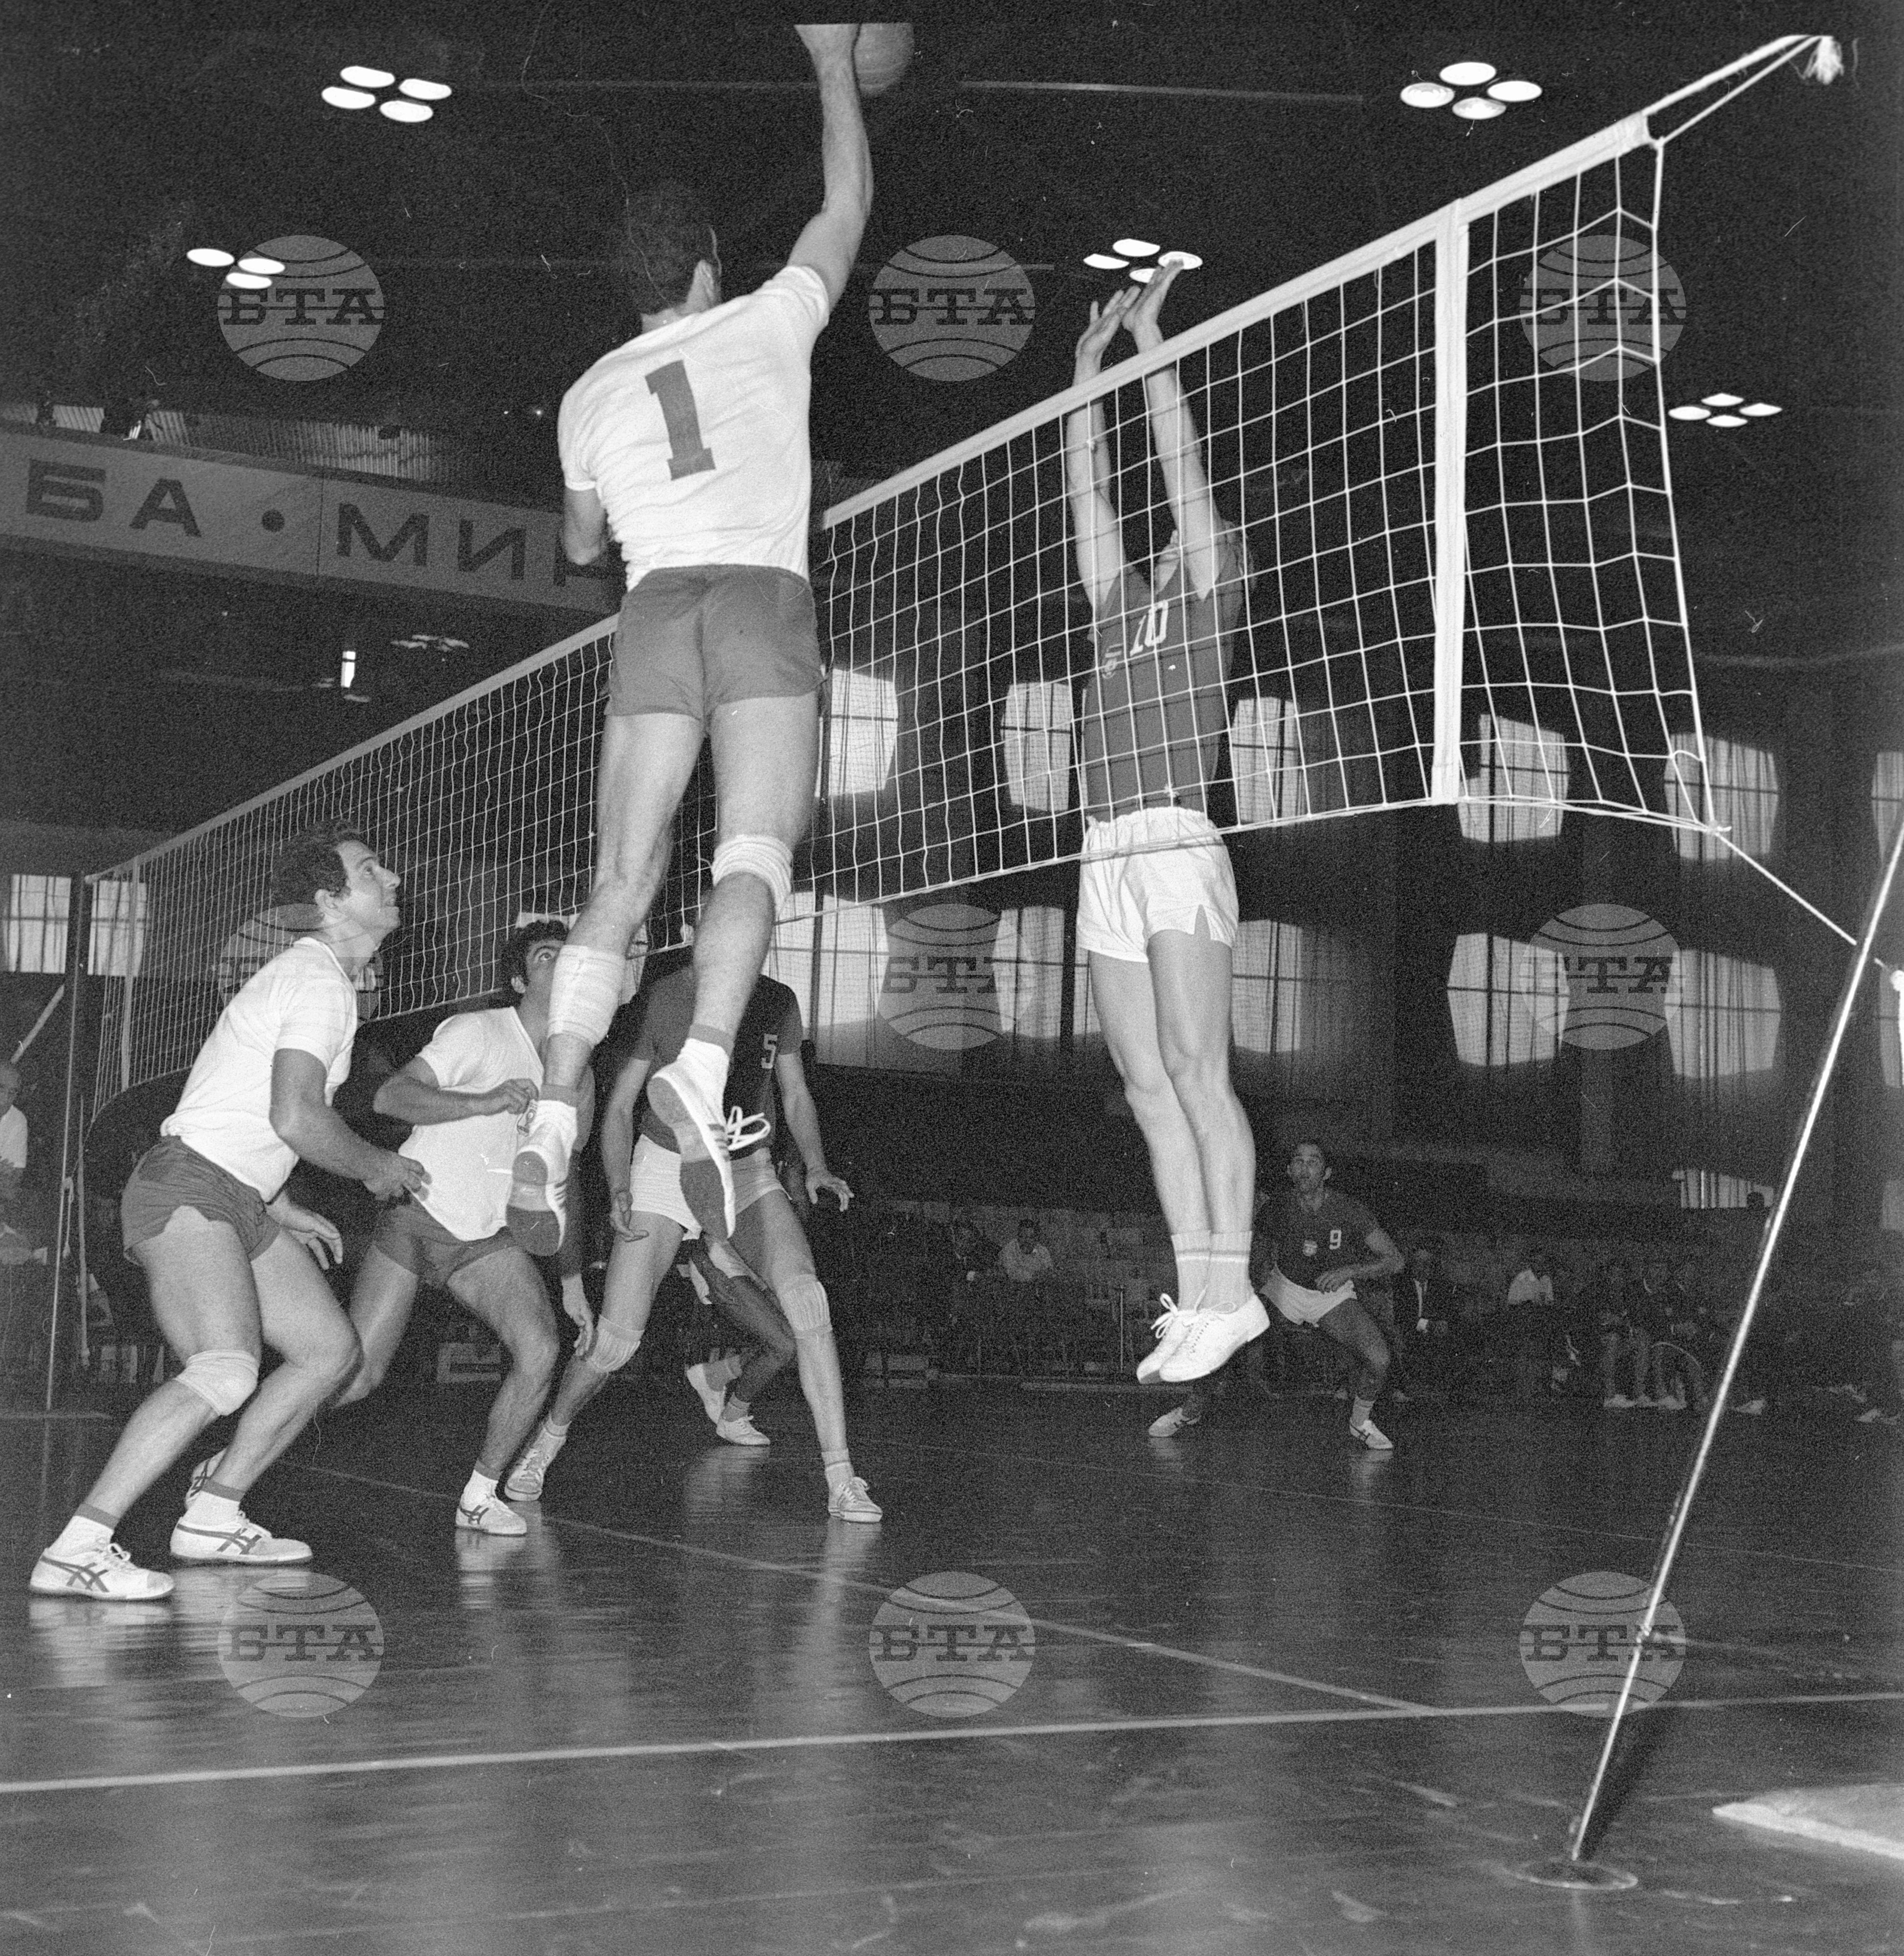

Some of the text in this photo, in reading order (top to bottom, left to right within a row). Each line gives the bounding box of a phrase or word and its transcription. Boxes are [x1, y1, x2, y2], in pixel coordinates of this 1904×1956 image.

[644, 359, 716, 481] 1
[1129, 599, 1169, 657] 10
[761, 1033, 778, 1069] 5
[1329, 1229, 1342, 1250] 9
